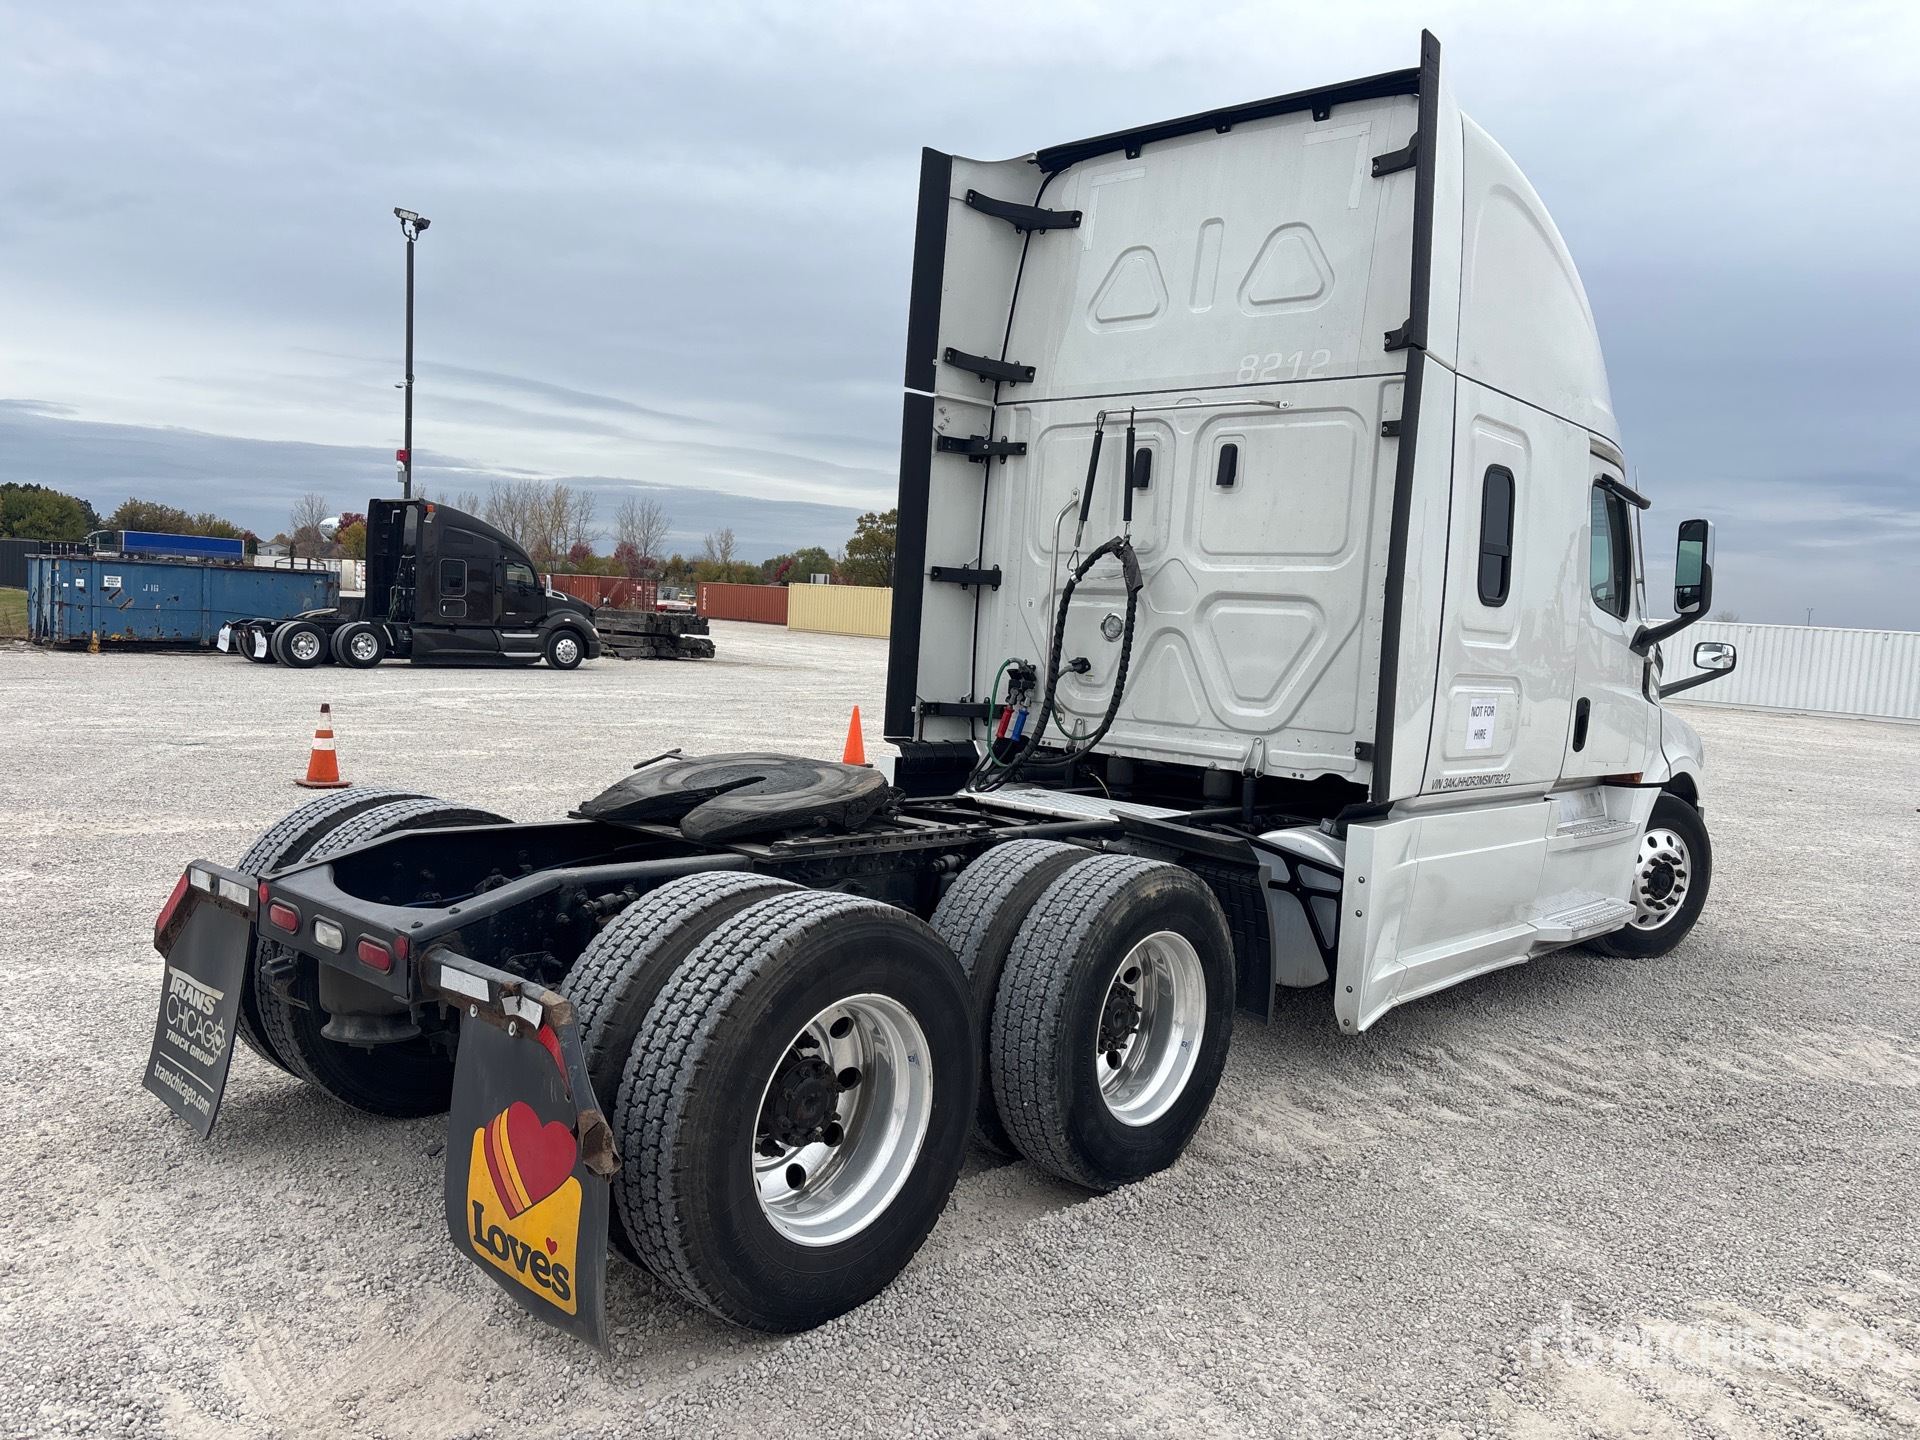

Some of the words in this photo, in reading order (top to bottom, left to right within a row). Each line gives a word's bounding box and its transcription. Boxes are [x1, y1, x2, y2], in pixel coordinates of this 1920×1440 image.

[1236, 348, 1331, 382] 8212
[1471, 706, 1483, 717] NOT
[1483, 705, 1495, 717] FOR
[1473, 729, 1487, 740] HIRE
[1431, 778, 1443, 790] VIN
[168, 965, 224, 1016] TRANS
[166, 994, 226, 1056] CHICAGO
[166, 1028, 190, 1052] TRUCK
[189, 1044, 215, 1067] GROUP
[154, 1060, 211, 1116] transchicago.com
